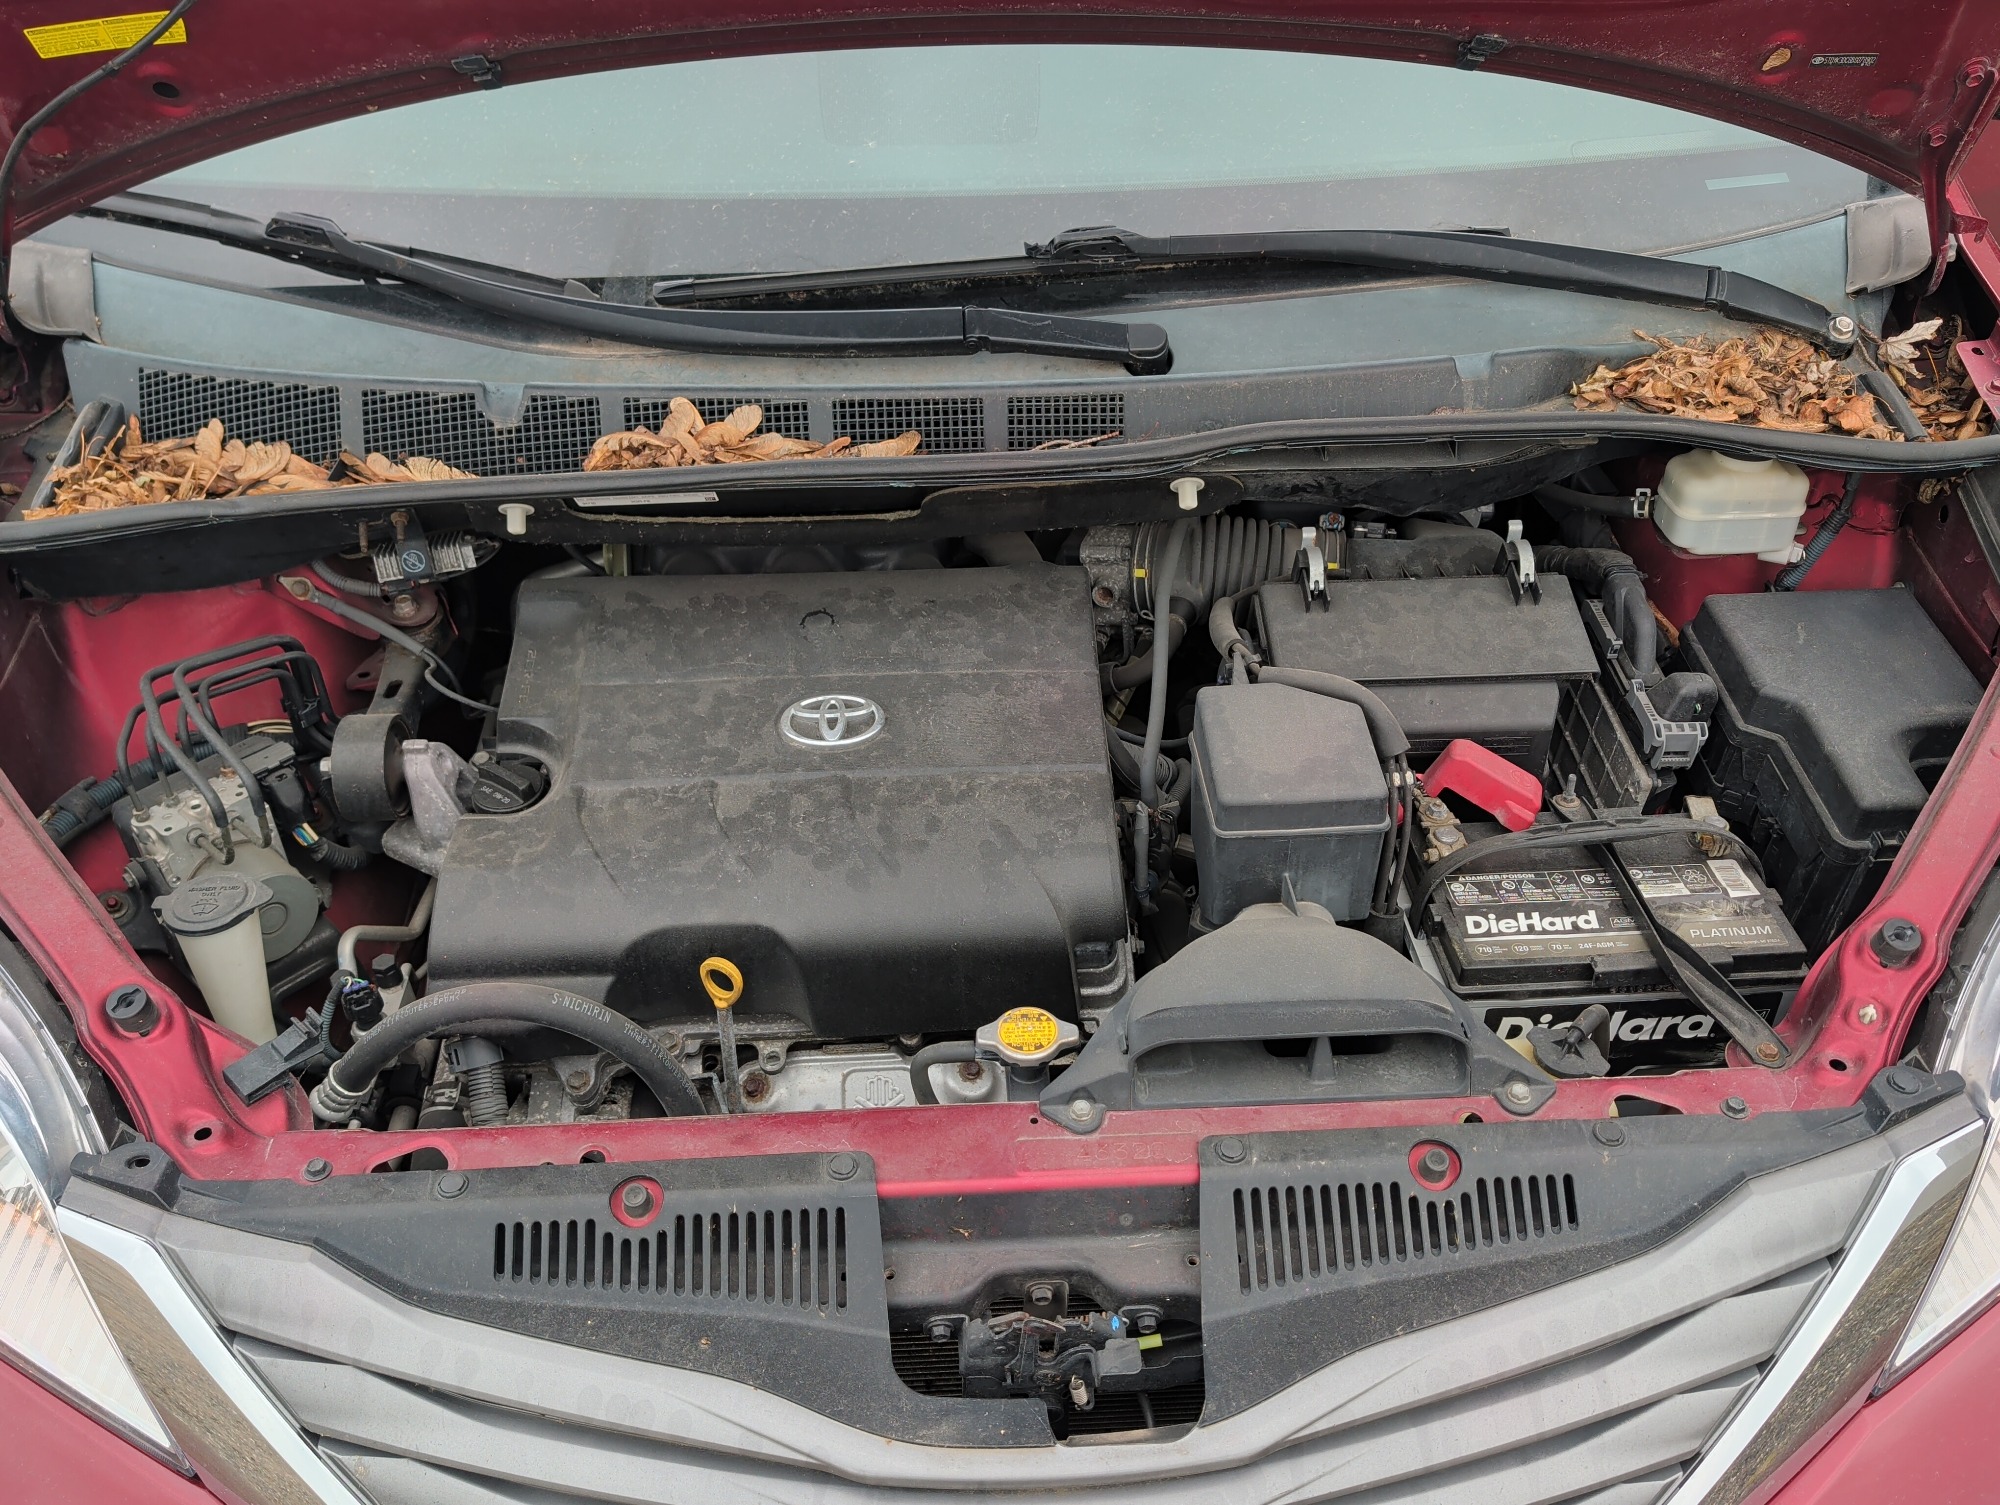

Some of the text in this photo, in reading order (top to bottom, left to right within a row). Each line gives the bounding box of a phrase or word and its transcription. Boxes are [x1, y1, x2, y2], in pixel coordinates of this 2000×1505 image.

[480, 785, 511, 804] SAE 0W-20
[1465, 873, 1535, 881] DANGER/POISON
[1465, 910, 1600, 935] DieHard
[1689, 925, 1772, 938] PLATINUM
[1578, 941, 1615, 949] 24F-AGM
